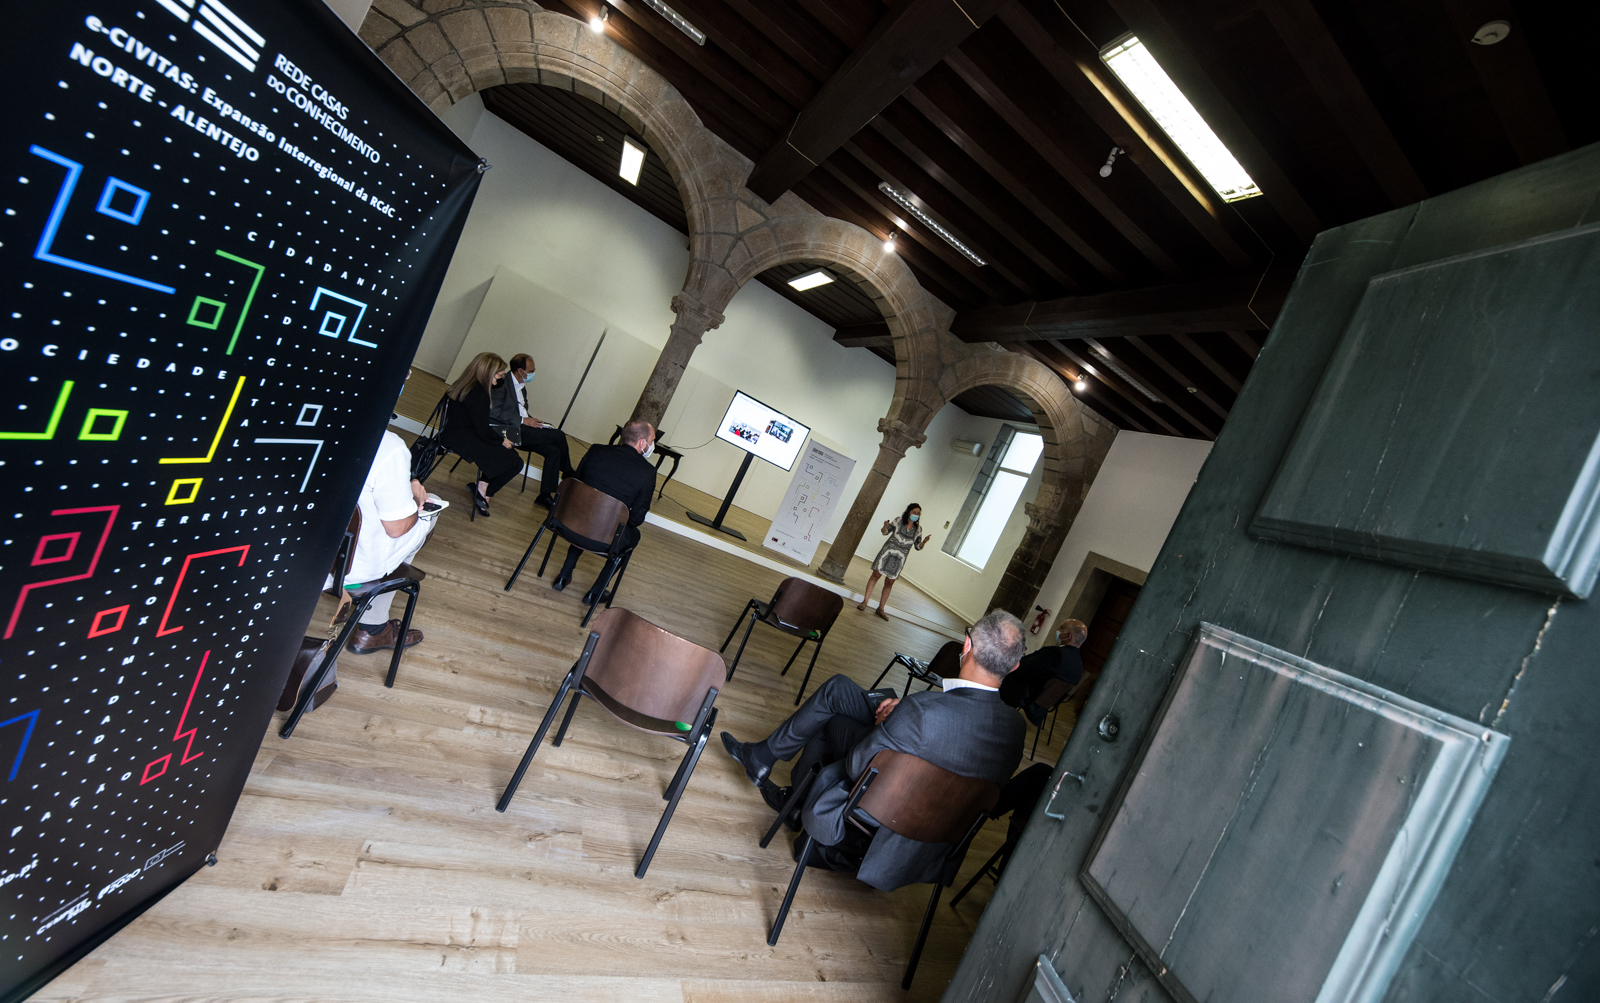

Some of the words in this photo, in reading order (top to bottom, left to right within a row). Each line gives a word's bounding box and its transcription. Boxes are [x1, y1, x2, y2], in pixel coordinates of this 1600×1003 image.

[69, 42, 156, 103] NORTE
[170, 104, 259, 161] ALENTEJO
[84, 15, 199, 94] e-CIVITAS:
[202, 87, 276, 142] Expansão
[278, 136, 355, 192] Interregional
[355, 187, 368, 202] da
[370, 195, 396, 218] RCdC
[266, 74, 286, 94] DO
[286, 87, 380, 163] CONHECIMENTO
[274, 53, 312, 91] REDE
[311, 84, 349, 120] CASAS
[247, 231, 388, 296] CIDADANIA
[232, 316, 292, 447] DIGITAL
[86, 556, 172, 764] PROXIMIDADE
[216, 537, 289, 707] TECNOLOGIAS
